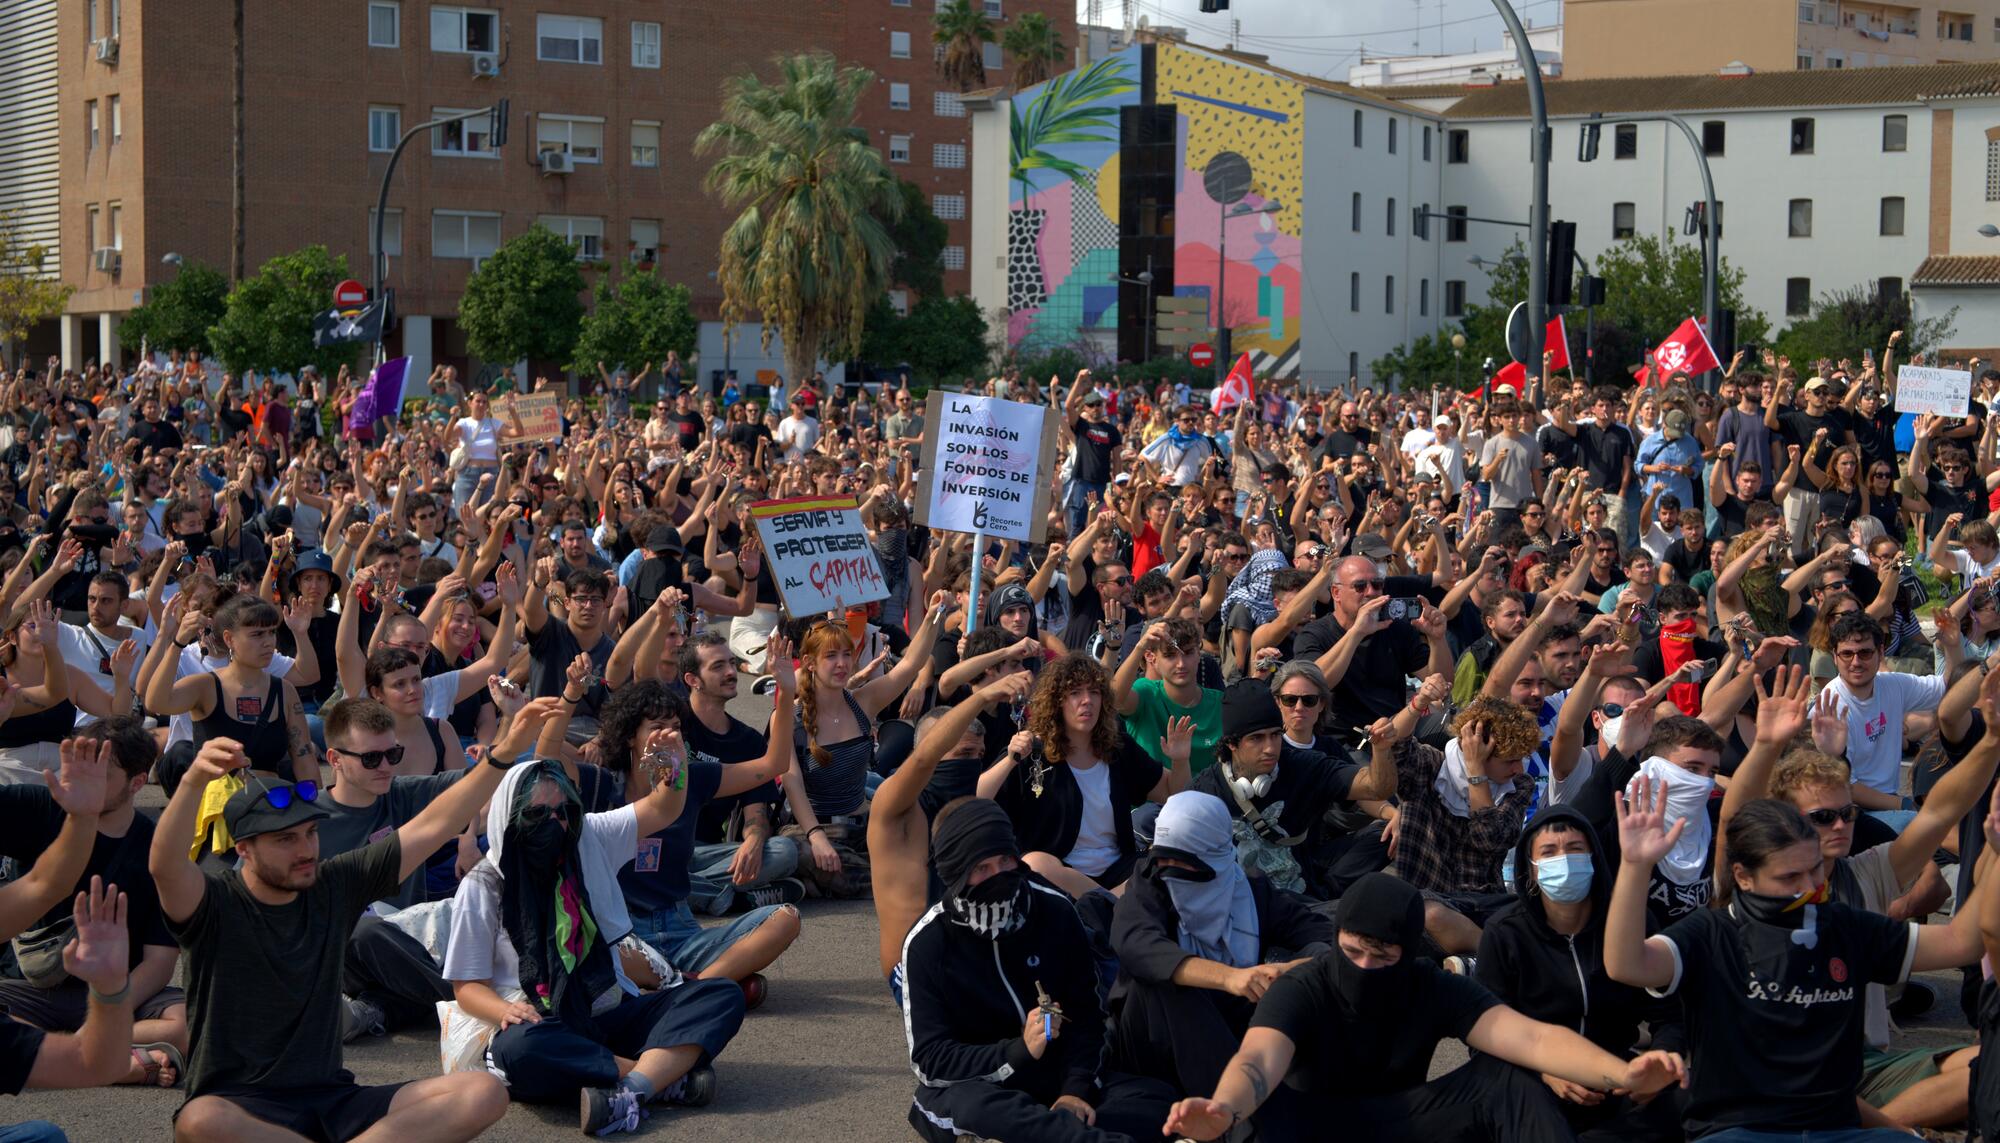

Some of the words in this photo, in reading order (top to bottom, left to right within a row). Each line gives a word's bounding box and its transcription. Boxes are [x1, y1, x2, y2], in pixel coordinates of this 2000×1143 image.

[951, 401, 972, 414] LA
[949, 422, 1019, 442] INVASIÓN
[946, 442, 977, 455] SON
[982, 447, 1009, 460] LOS
[944, 460, 1007, 480] FONDOS
[1010, 471, 1029, 484] DE
[942, 480, 1021, 503] INVERSIÓN
[771, 510, 831, 534] SERVIR
[990, 516, 1023, 527] Recortes
[773, 533, 868, 560] PROTEGER
[785, 576, 803, 590] AL
[809, 555, 881, 598] CAPITAL
